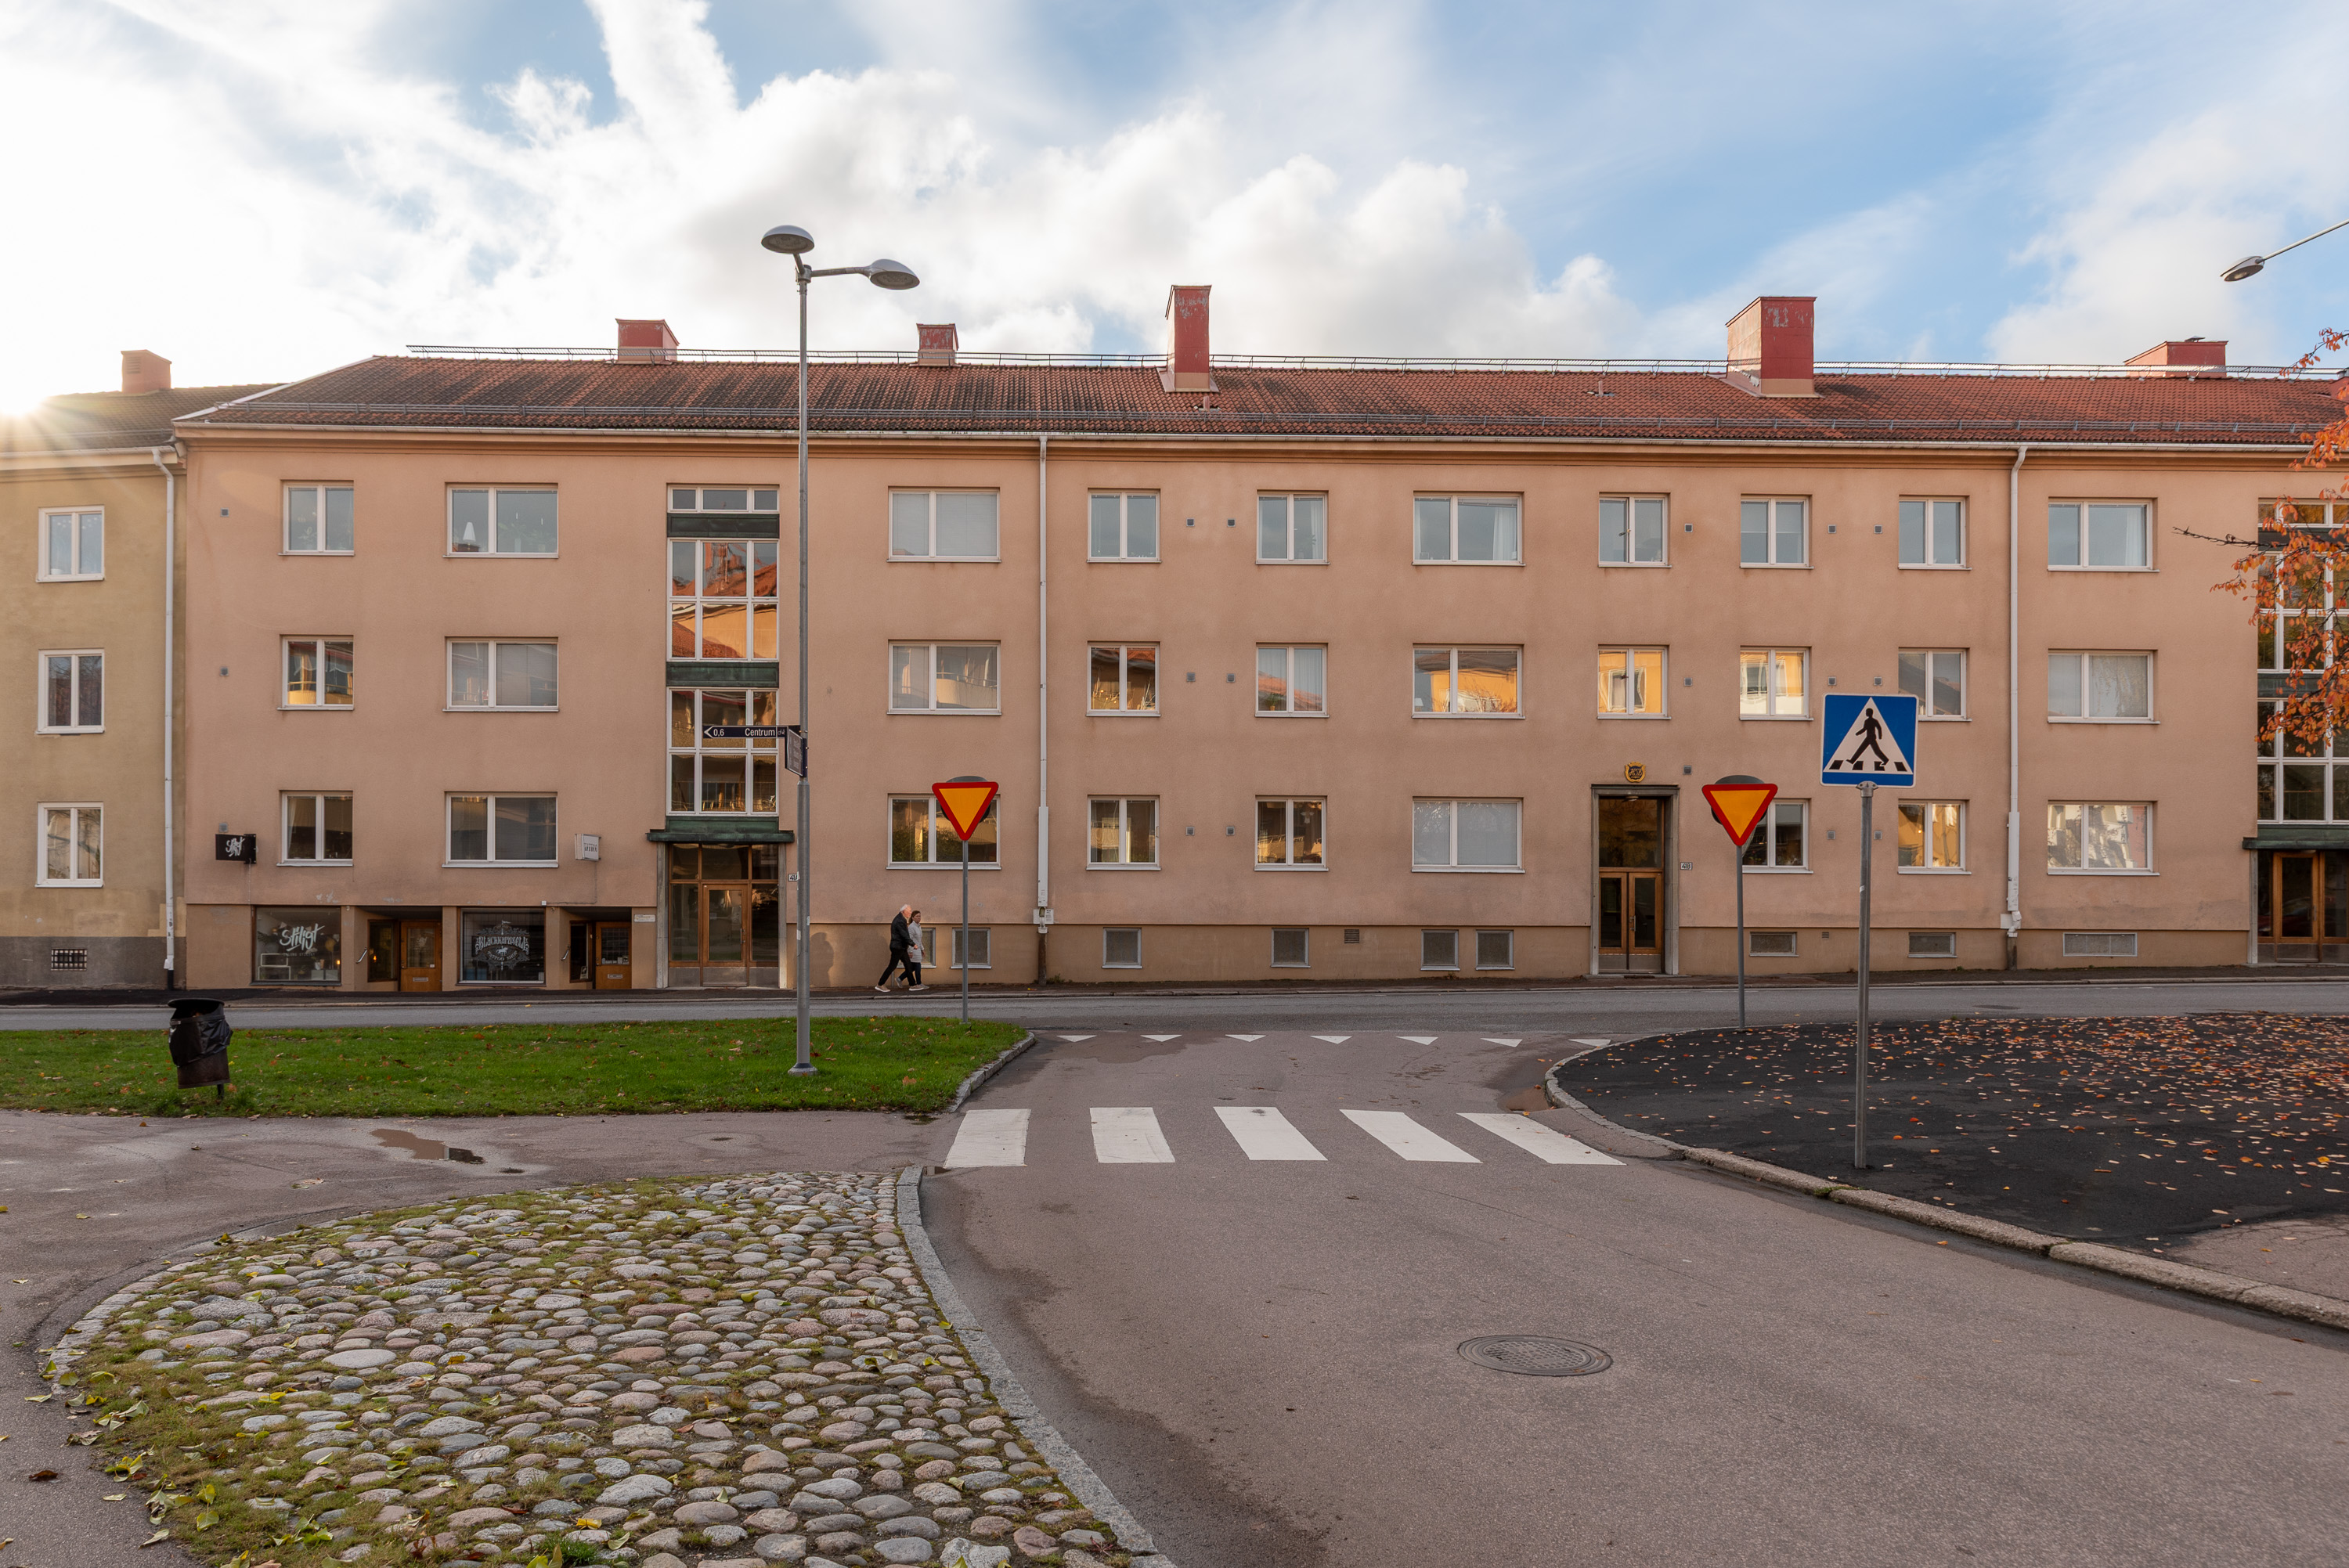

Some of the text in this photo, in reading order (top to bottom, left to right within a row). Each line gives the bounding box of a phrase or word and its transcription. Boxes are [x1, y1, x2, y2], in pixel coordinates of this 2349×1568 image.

[279, 923, 326, 952] Stiligt
[487, 950, 518, 961] TATTOO SHOP
